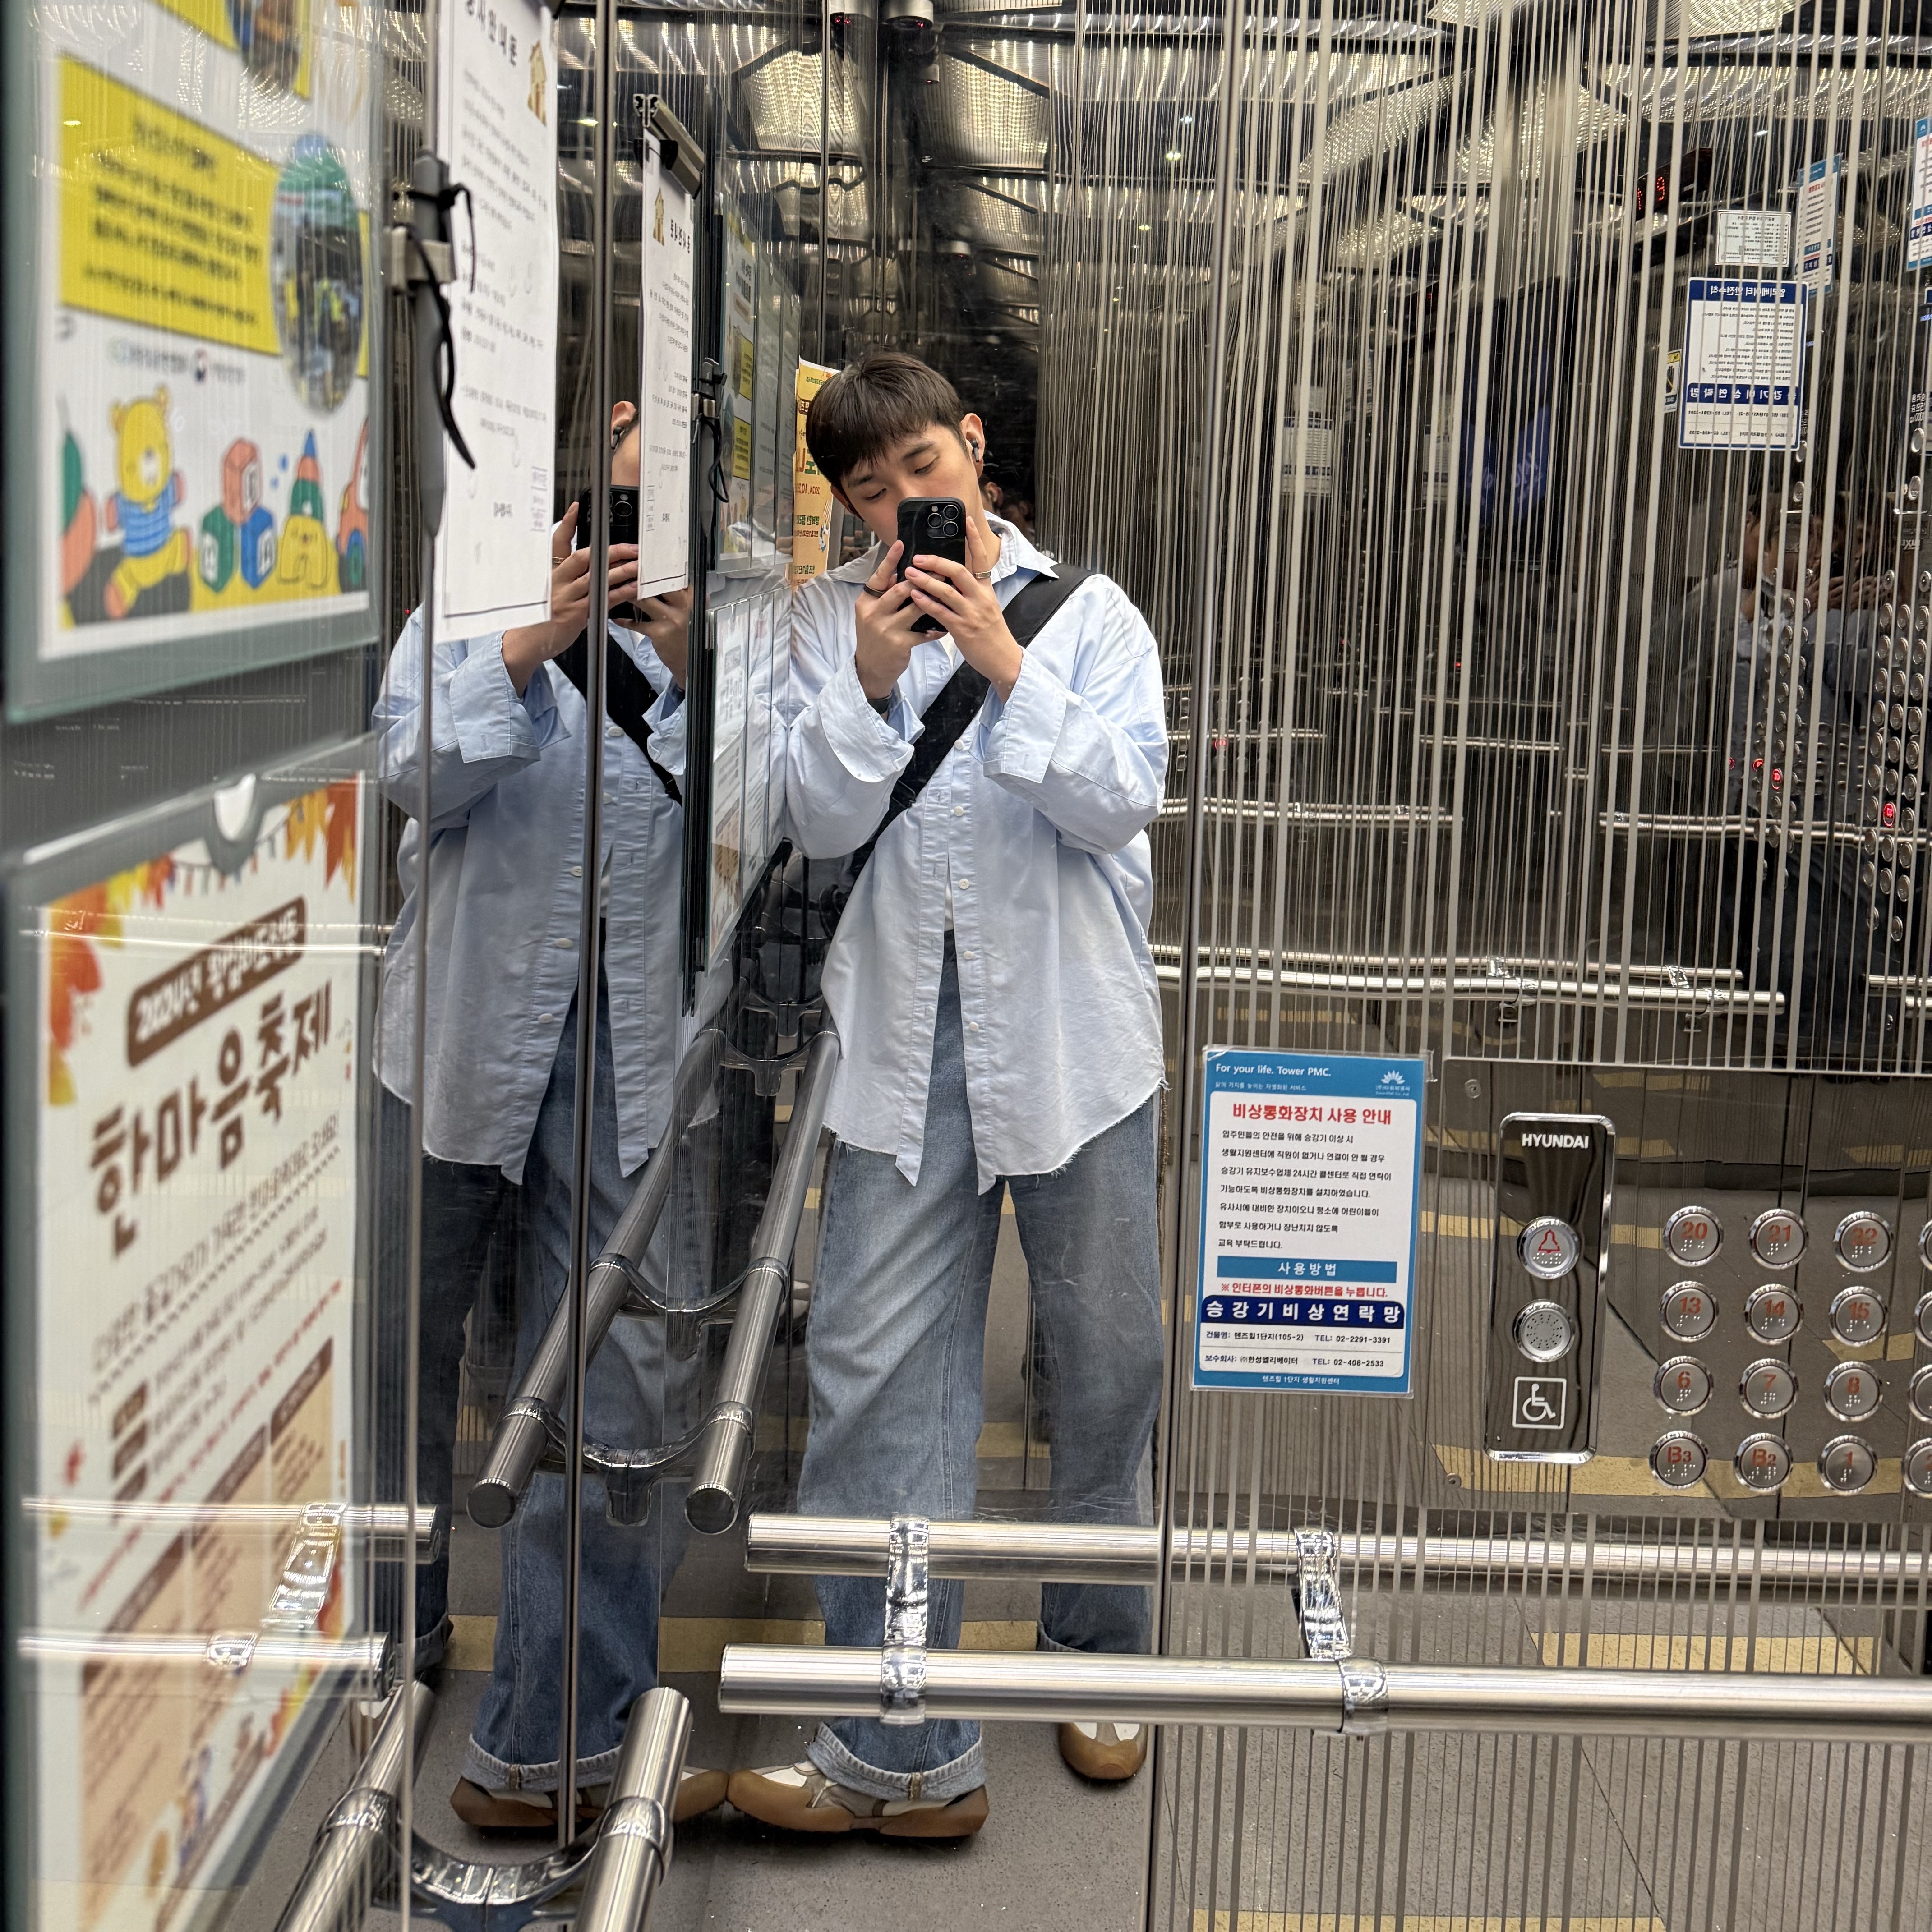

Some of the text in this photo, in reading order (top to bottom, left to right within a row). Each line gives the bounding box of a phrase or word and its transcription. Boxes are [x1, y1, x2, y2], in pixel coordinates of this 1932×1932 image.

[1216, 1063, 1331, 1077] For your life. Tower PMC.
[88, 980, 333, 1260] 한마음축제
[1233, 1103, 1391, 1125] 비상통화장치 사용 안내
[1222, 1130, 1353, 1144] 입주민들의 안전을 위해 승강기 이상 시
[1521, 1132, 1589, 1150] HYUNDAI
[1222, 1148, 1385, 1162] 생활지원센터에 직원이 없거나 연결이 안 될 경우
[1221, 1166, 1391, 1181] 승강기 유지보수업체 24시간 콜센터로 직접 연락이
[1220, 1184, 1370, 1198] 가능하도록 비상통화장치를 설치하였습니다.
[1220, 1202, 1379, 1216] 유사시에 대비한 장치이오니 평소에 어린이들이
[1243, 1222, 1282, 1231] 사용하거나
[1284, 1223, 1314, 1232] 장난치지
[1316, 1224, 1338, 1233] 않도록
[1680, 1221, 1708, 1242] 20
[1767, 1224, 1792, 1243] 21
[1218, 1239, 1282, 1249] 교육 부탁드립니다.
[1852, 1227, 1877, 1246] 22
[1278, 1261, 1336, 1276] 사용방법
[1232, 1283, 1271, 1294] 인터폰의
[1274, 1284, 1343, 1297] 비상통화버튼을
[1346, 1286, 1388, 1298] 누릅니다.
[1679, 1296, 1701, 1316] 13
[1764, 1299, 1785, 1318] 14
[1849, 1302, 1870, 1321] 15
[1206, 1331, 1231, 1339] 건물명:
[1234, 1332, 1304, 1341] 텐즈힐1단지(105-2)
[1336, 1335, 1391, 1343] 02-2291-3391
[1205, 1355, 1237, 1363] 보수회사:
[1333, 1359, 1384, 1367] 02-408-2533
[1302, 1377, 1339, 1385] 생활지원센터
[1677, 1371, 1691, 1389] 6
[1763, 1374, 1777, 1391] 7
[1846, 1376, 1860, 1394] 8
[1667, 1446, 1692, 1464] B3
[1752, 1448, 1777, 1466] B2
[1845, 1451, 1854, 1467] 1
